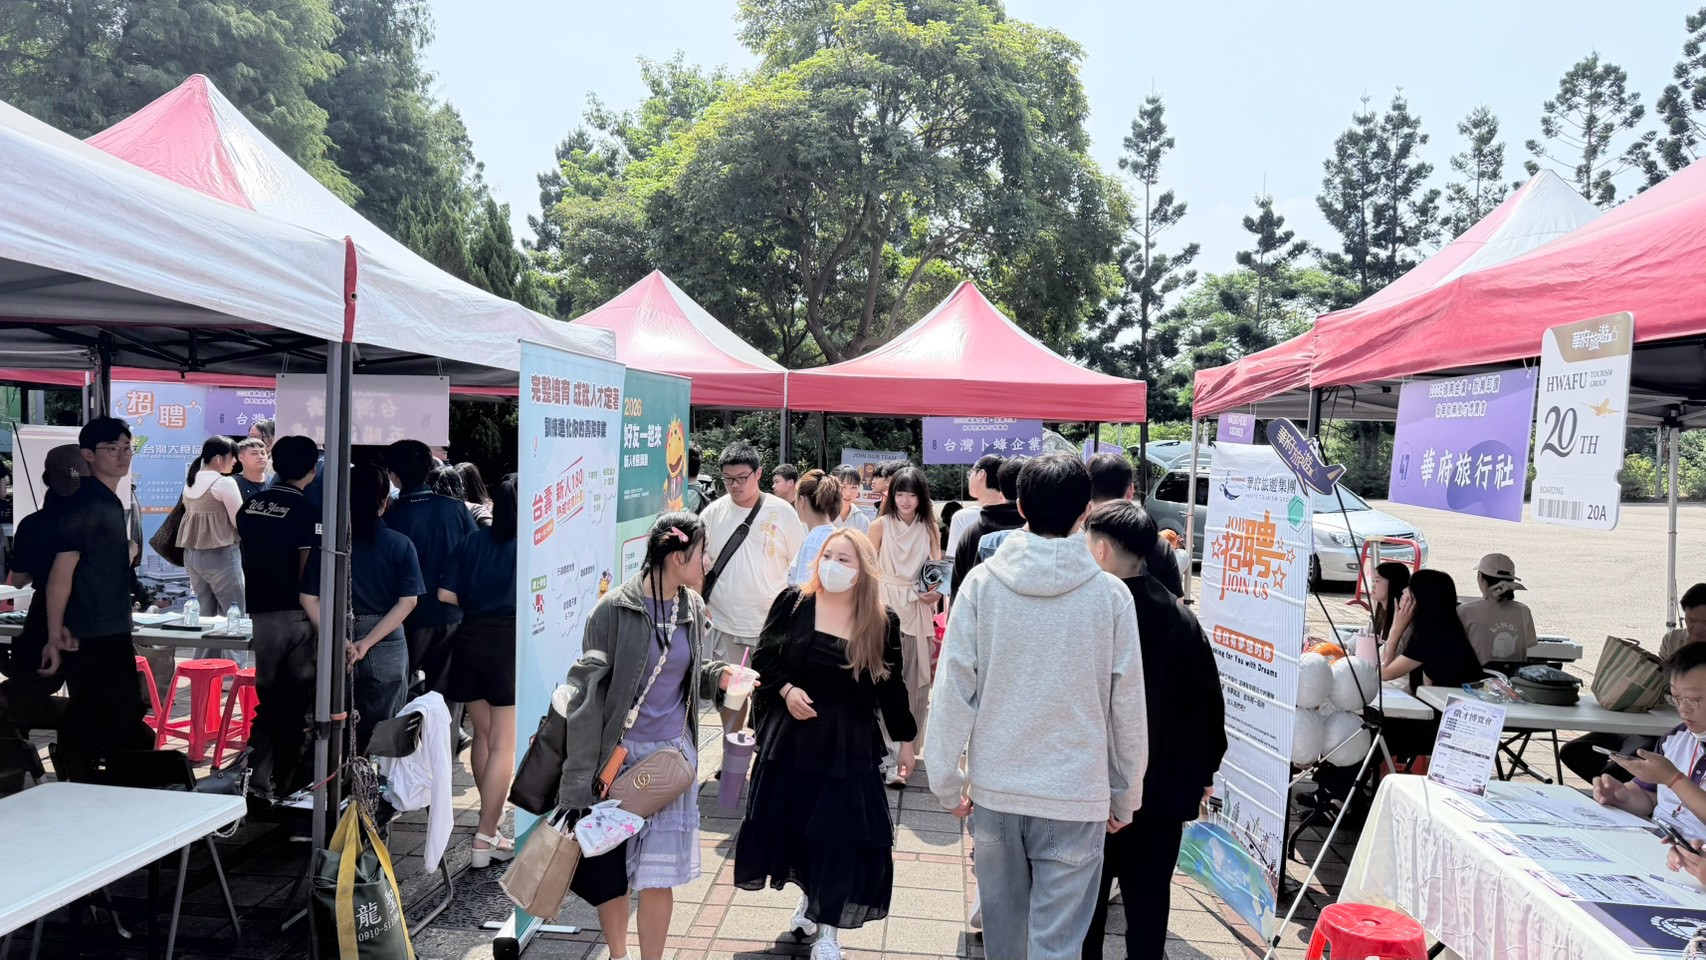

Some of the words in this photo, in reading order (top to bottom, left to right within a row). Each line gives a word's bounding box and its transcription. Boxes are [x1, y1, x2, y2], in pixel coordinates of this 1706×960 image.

[1546, 371, 1588, 392] HWAFU
[1589, 379, 1608, 388] GROUP
[1590, 368, 1613, 378] TOURISM
[127, 390, 186, 428] 招聘
[624, 396, 643, 417] 2026
[623, 423, 662, 448] 好友一起來
[1541, 405, 1578, 457] 20
[1580, 435, 1600, 454] TH
[944, 436, 1042, 452] 台灣卜蜂企業
[1421, 447, 1514, 491] 華府旅行社
[1247, 475, 1297, 495] 華府旅遊集團
[1540, 485, 1564, 495] BOARDING
[249, 499, 265, 510] Wu
[264, 502, 290, 515] Yang
[1587, 504, 1607, 521] 20A
[1225, 515, 1245, 532] JOB
[1219, 509, 1287, 601] 招聘
[1226, 573, 1250, 596] JOIN
[1253, 580, 1269, 600] US
[1225, 651, 1233, 661] for
[1234, 654, 1244, 665] You
[1245, 659, 1257, 669] with
[1257, 663, 1278, 678] Dreams
